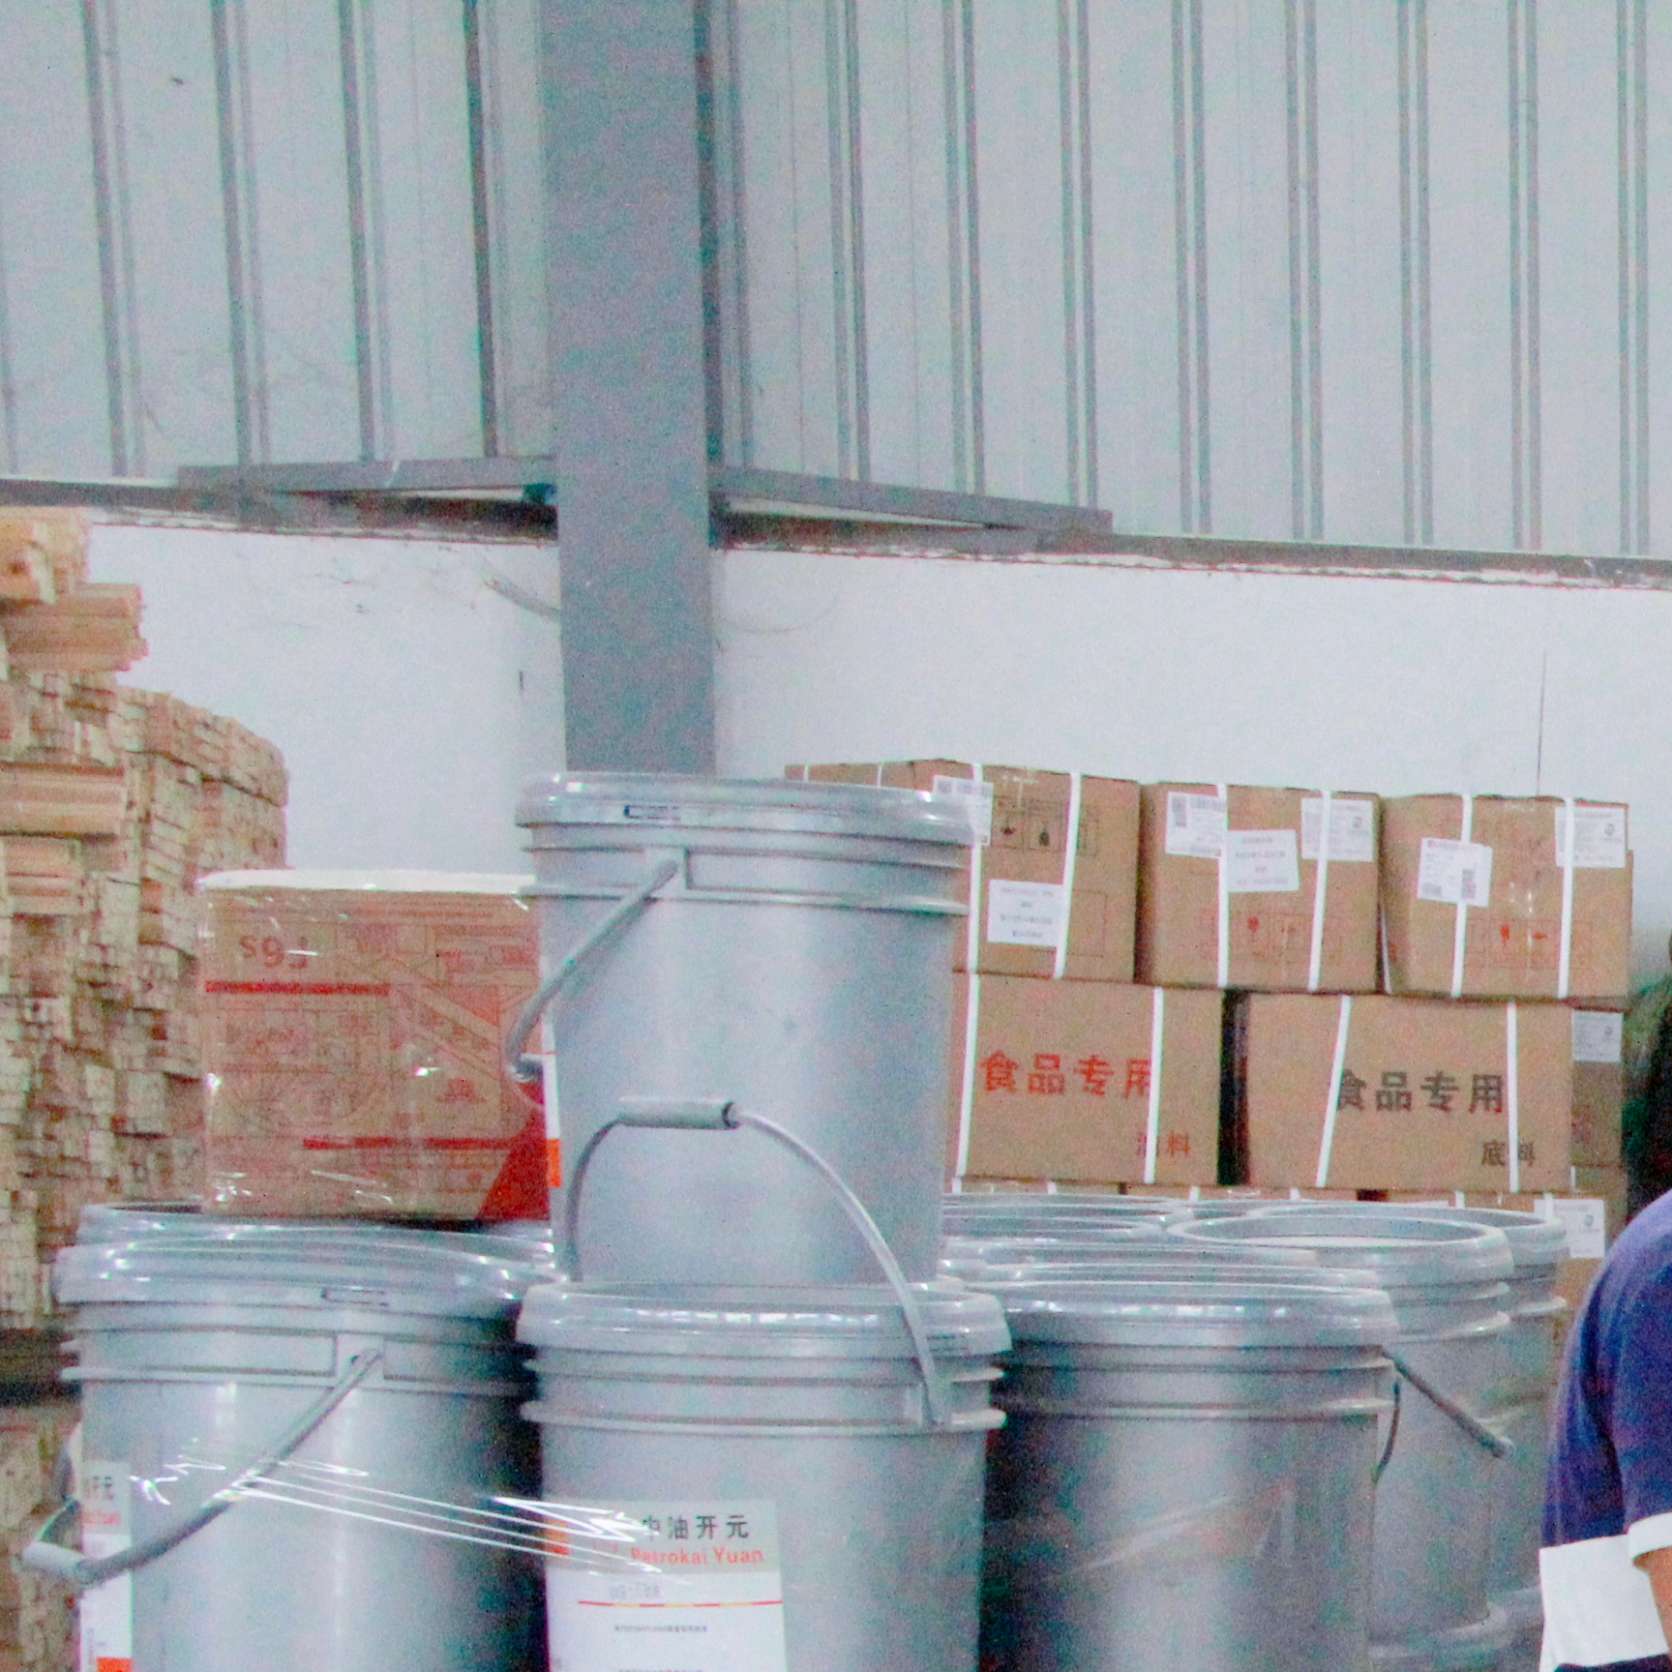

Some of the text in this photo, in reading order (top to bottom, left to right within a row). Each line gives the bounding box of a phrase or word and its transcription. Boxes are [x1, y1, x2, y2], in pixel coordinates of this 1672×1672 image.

[979, 1051, 1152, 1100] 食品专用
[1337, 1069, 1505, 1115] 食品专用
